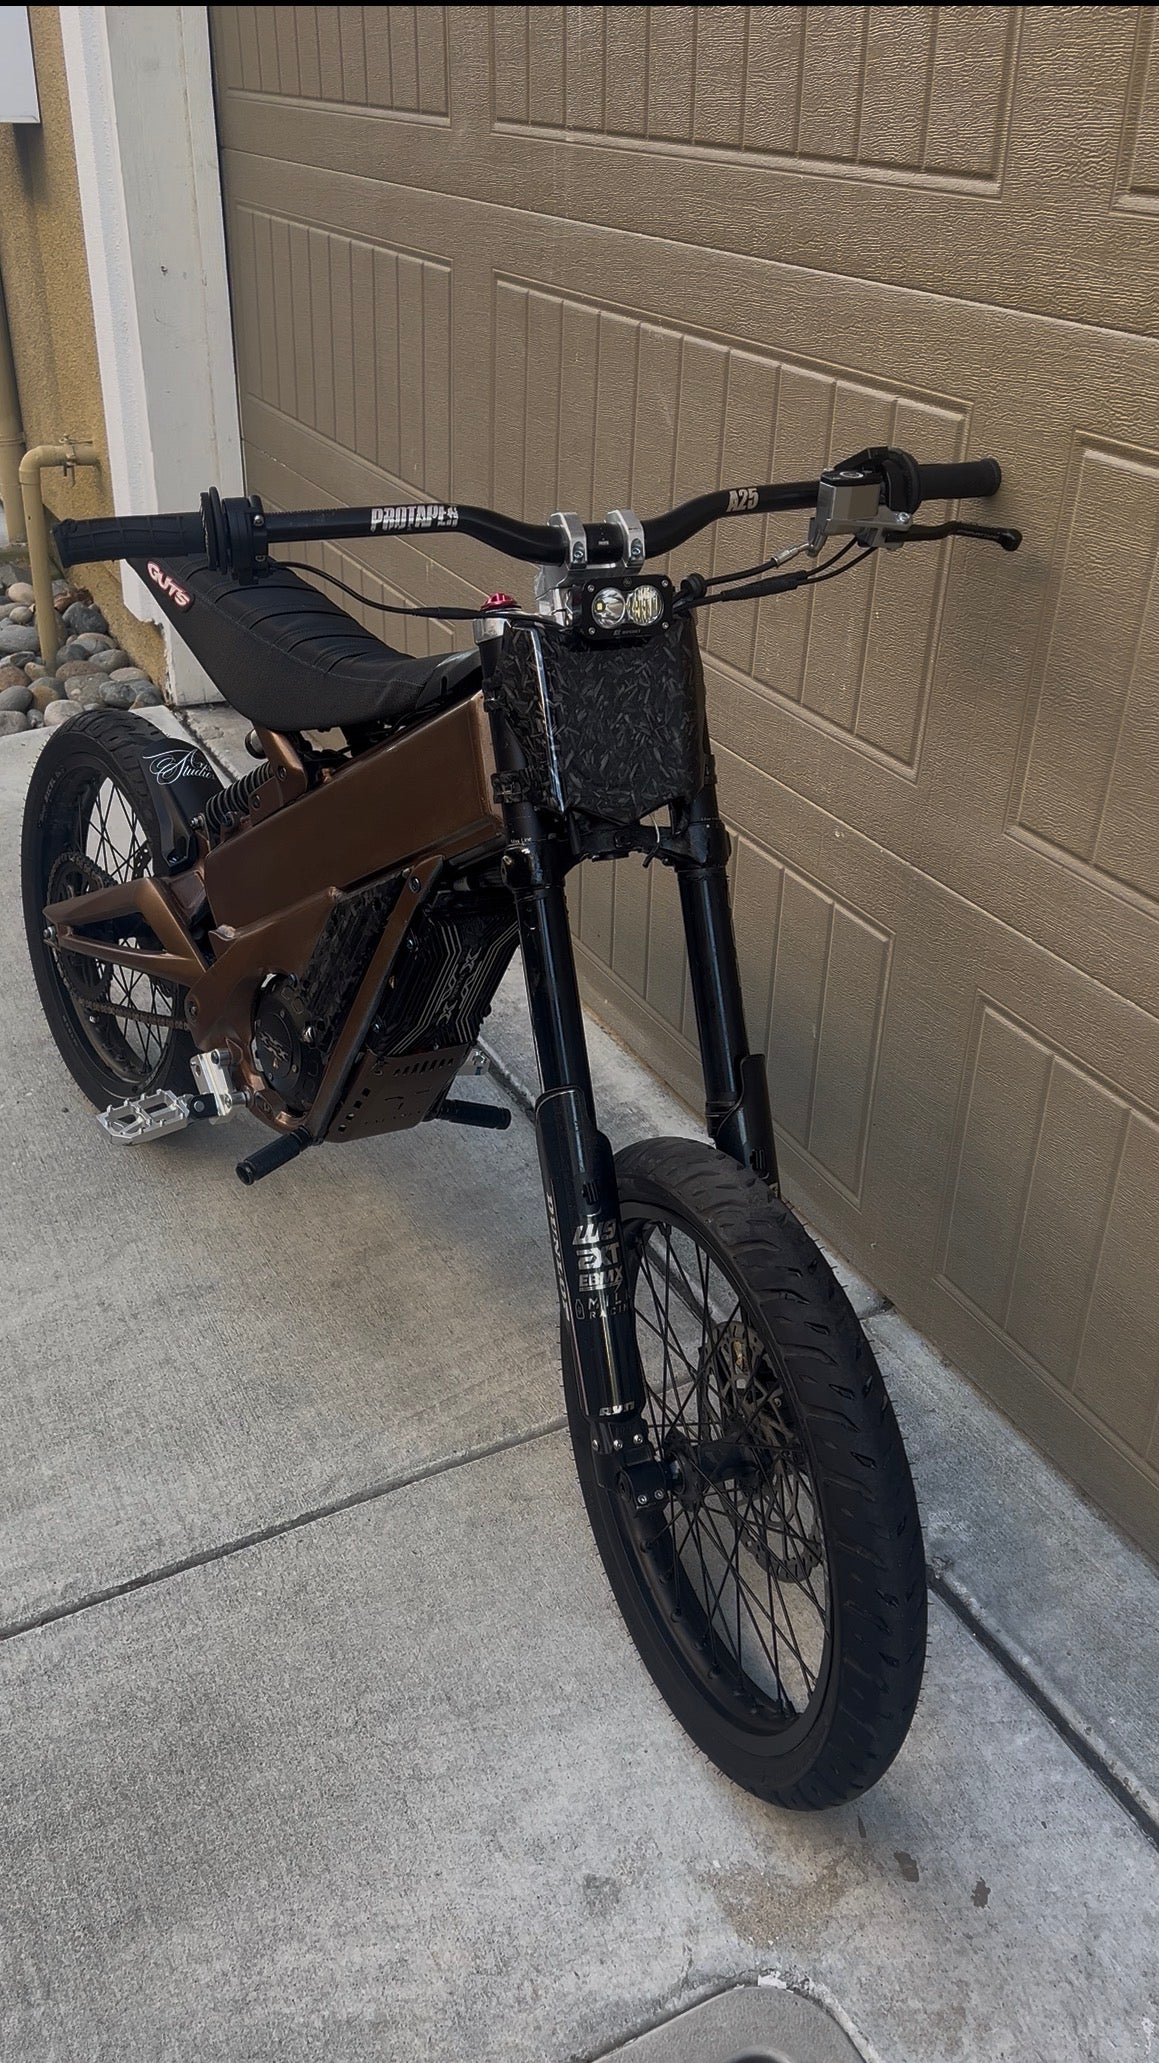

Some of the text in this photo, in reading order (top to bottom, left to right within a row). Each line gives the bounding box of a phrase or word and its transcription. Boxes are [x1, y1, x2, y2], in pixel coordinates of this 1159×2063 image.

[726, 487, 759, 512] A25
[370, 504, 459, 532] PROTAPER
[147, 560, 190, 606] GUTS
[579, 1265, 623, 1289] EBMX
[588, 1291, 628, 1310] MIL
